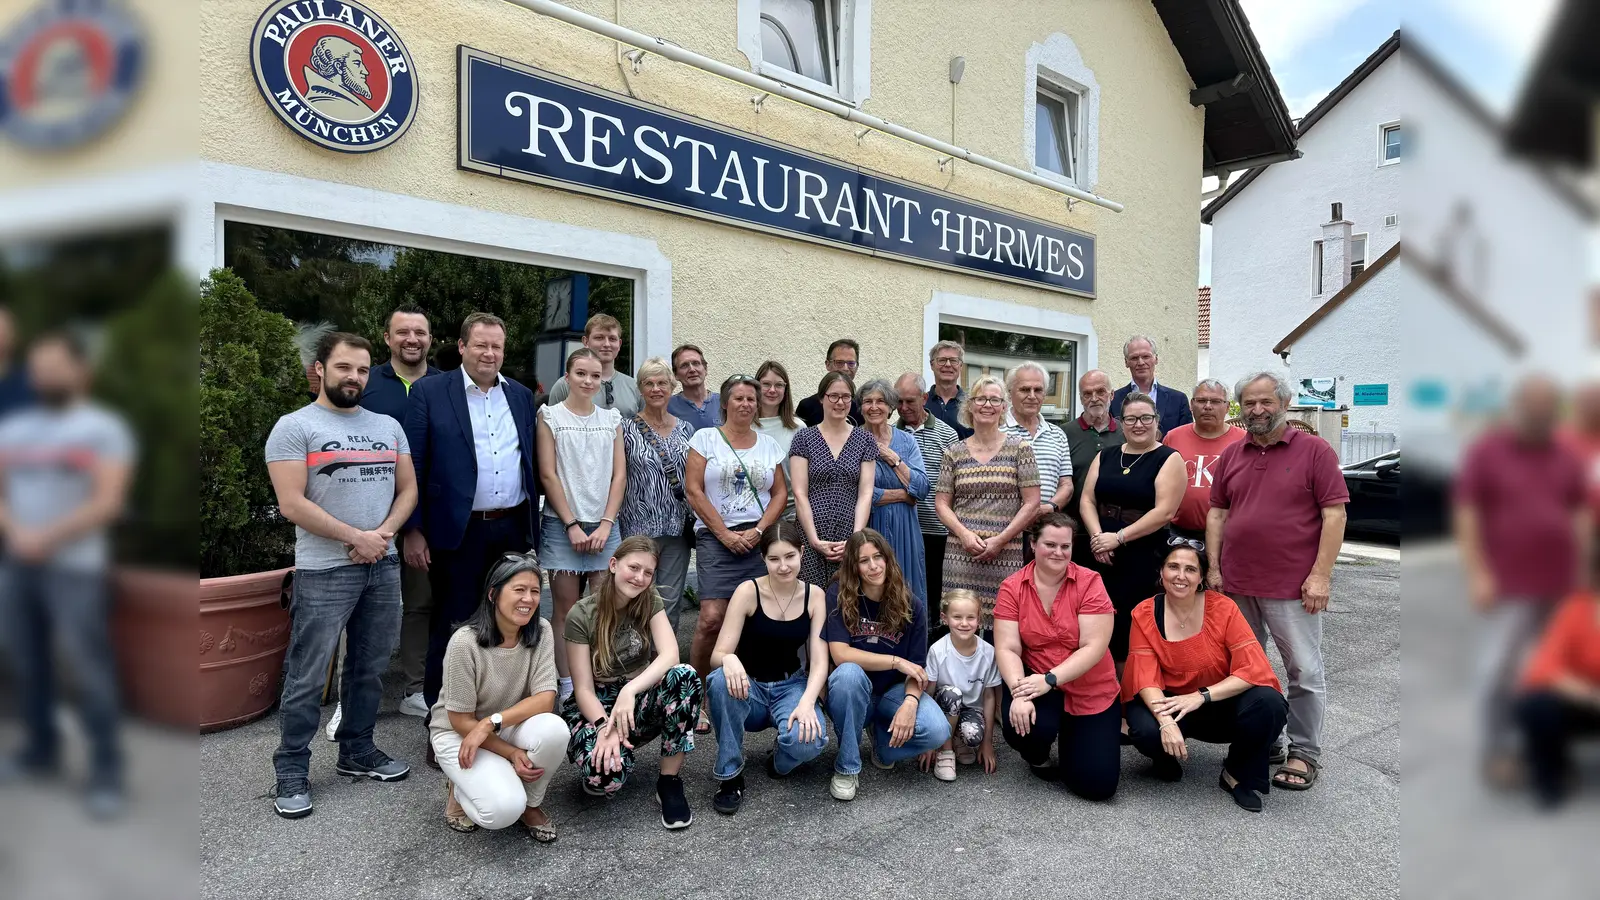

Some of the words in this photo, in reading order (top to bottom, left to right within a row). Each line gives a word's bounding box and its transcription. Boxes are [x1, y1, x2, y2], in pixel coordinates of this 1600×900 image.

[264, 0, 408, 77] PAULANER
[275, 87, 399, 143] MÜNCHEN
[504, 90, 921, 244] RESTAURANT
[931, 208, 1084, 280] HERMES
